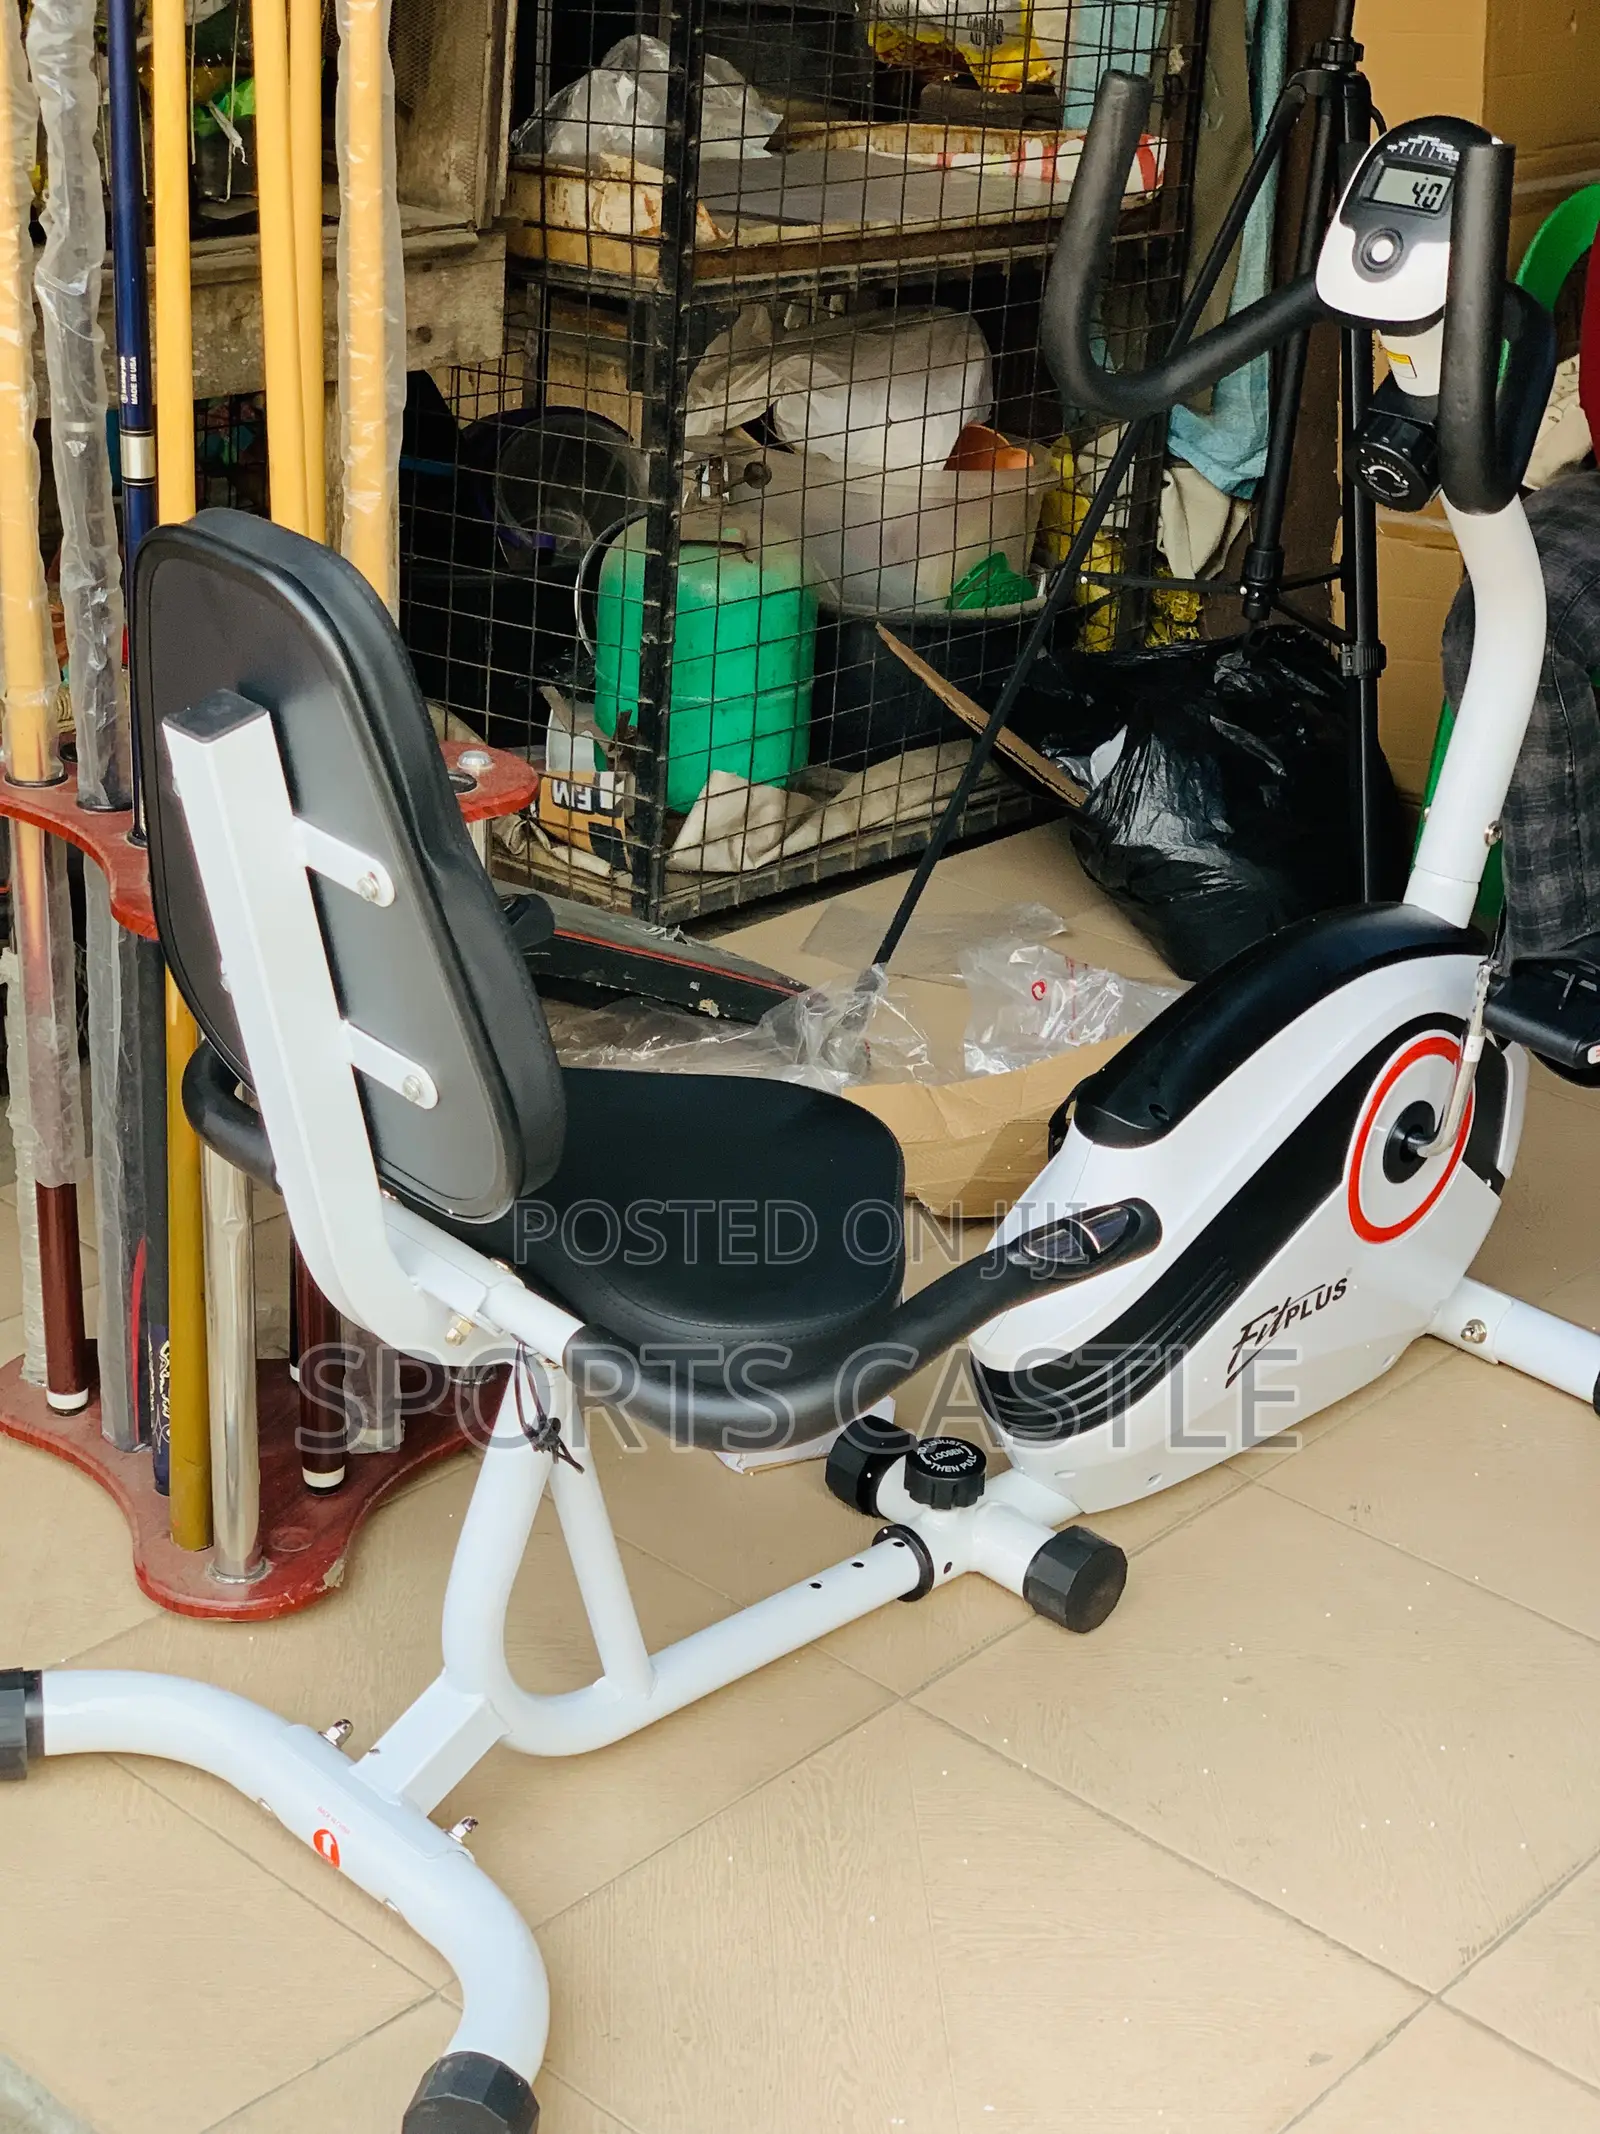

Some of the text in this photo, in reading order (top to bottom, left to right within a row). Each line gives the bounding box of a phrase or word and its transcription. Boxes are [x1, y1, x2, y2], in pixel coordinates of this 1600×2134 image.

[129, 356, 137, 373] USA
[130, 382, 138, 404] MADE
[923, 1439, 963, 1449] ADJUST
[929, 1447, 965, 1461] LOOSEN
[930, 1454, 977, 1473] THEN PULL
